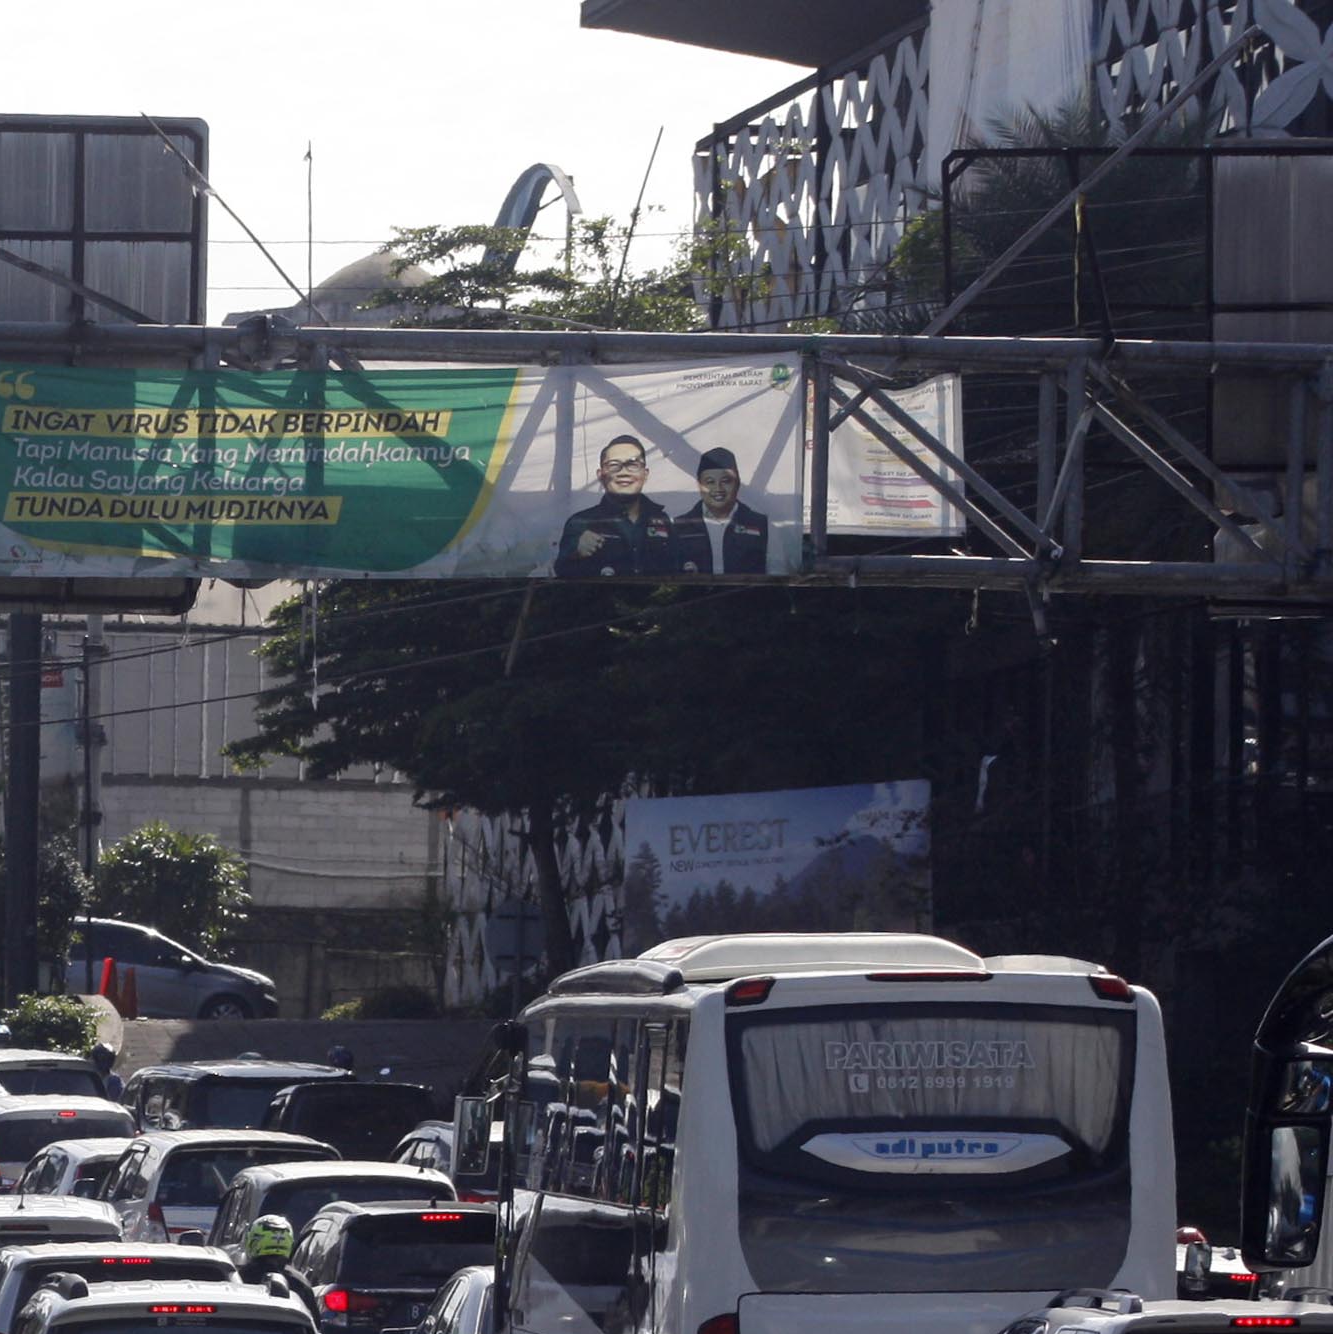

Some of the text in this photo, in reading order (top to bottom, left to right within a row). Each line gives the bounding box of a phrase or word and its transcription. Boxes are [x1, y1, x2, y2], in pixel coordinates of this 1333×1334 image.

[10, 410, 440, 434] INGAT VIRUS TIDAK BERPINDAH
[14, 438, 470, 467] Tapi Manusia Yang Memindahkannya
[14, 466, 304, 498] Kalau Sayang Keluarga
[15, 497, 330, 521] TUNDA DULU MUDIKNYA
[669, 818, 789, 856] EVEREST
[825, 1041, 1035, 1070] PARIWISATA
[876, 1075, 1015, 1089] 0812 8999 1919
[921, 1139, 999, 1158] putra
